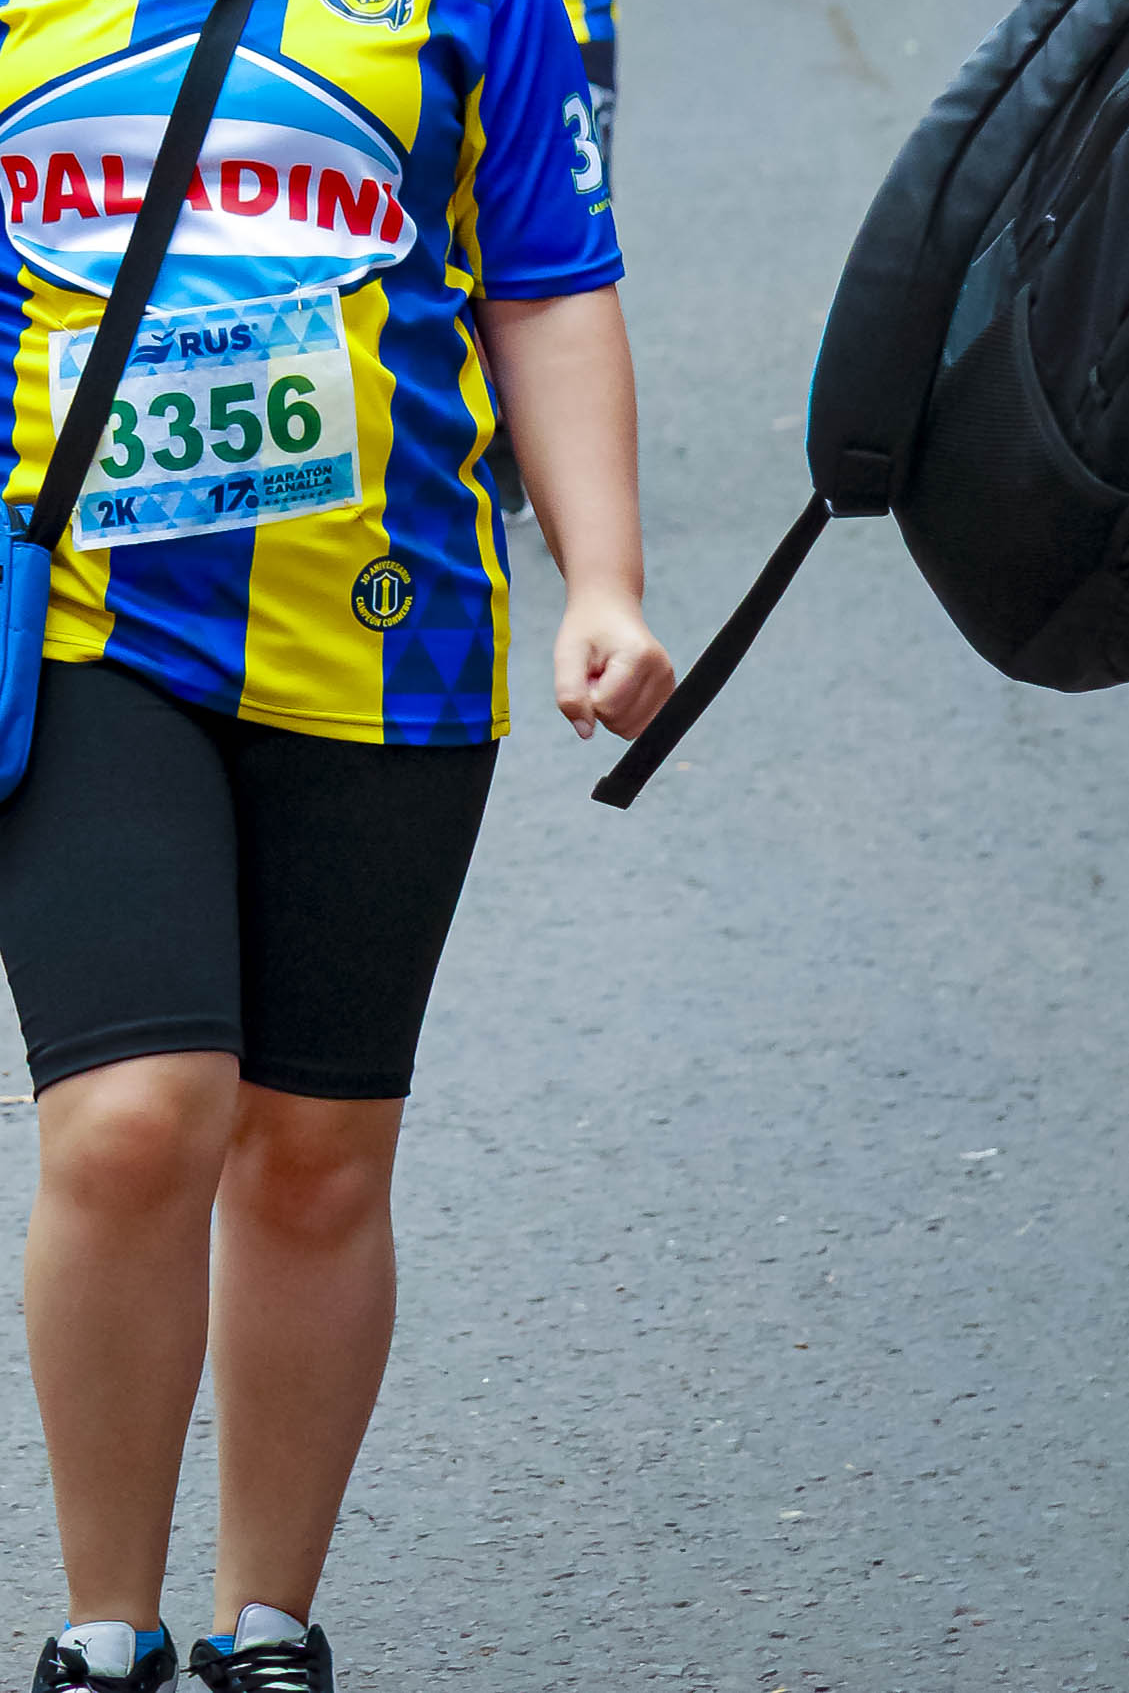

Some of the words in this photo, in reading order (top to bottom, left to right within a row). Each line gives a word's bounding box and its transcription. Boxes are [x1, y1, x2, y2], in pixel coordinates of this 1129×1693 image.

[179, 323, 253, 358] RUS
[99, 374, 322, 480] 3356
[208, 477, 258, 513] 17
[265, 476, 332, 495] CANALLA
[97, 496, 139, 528] 2K
